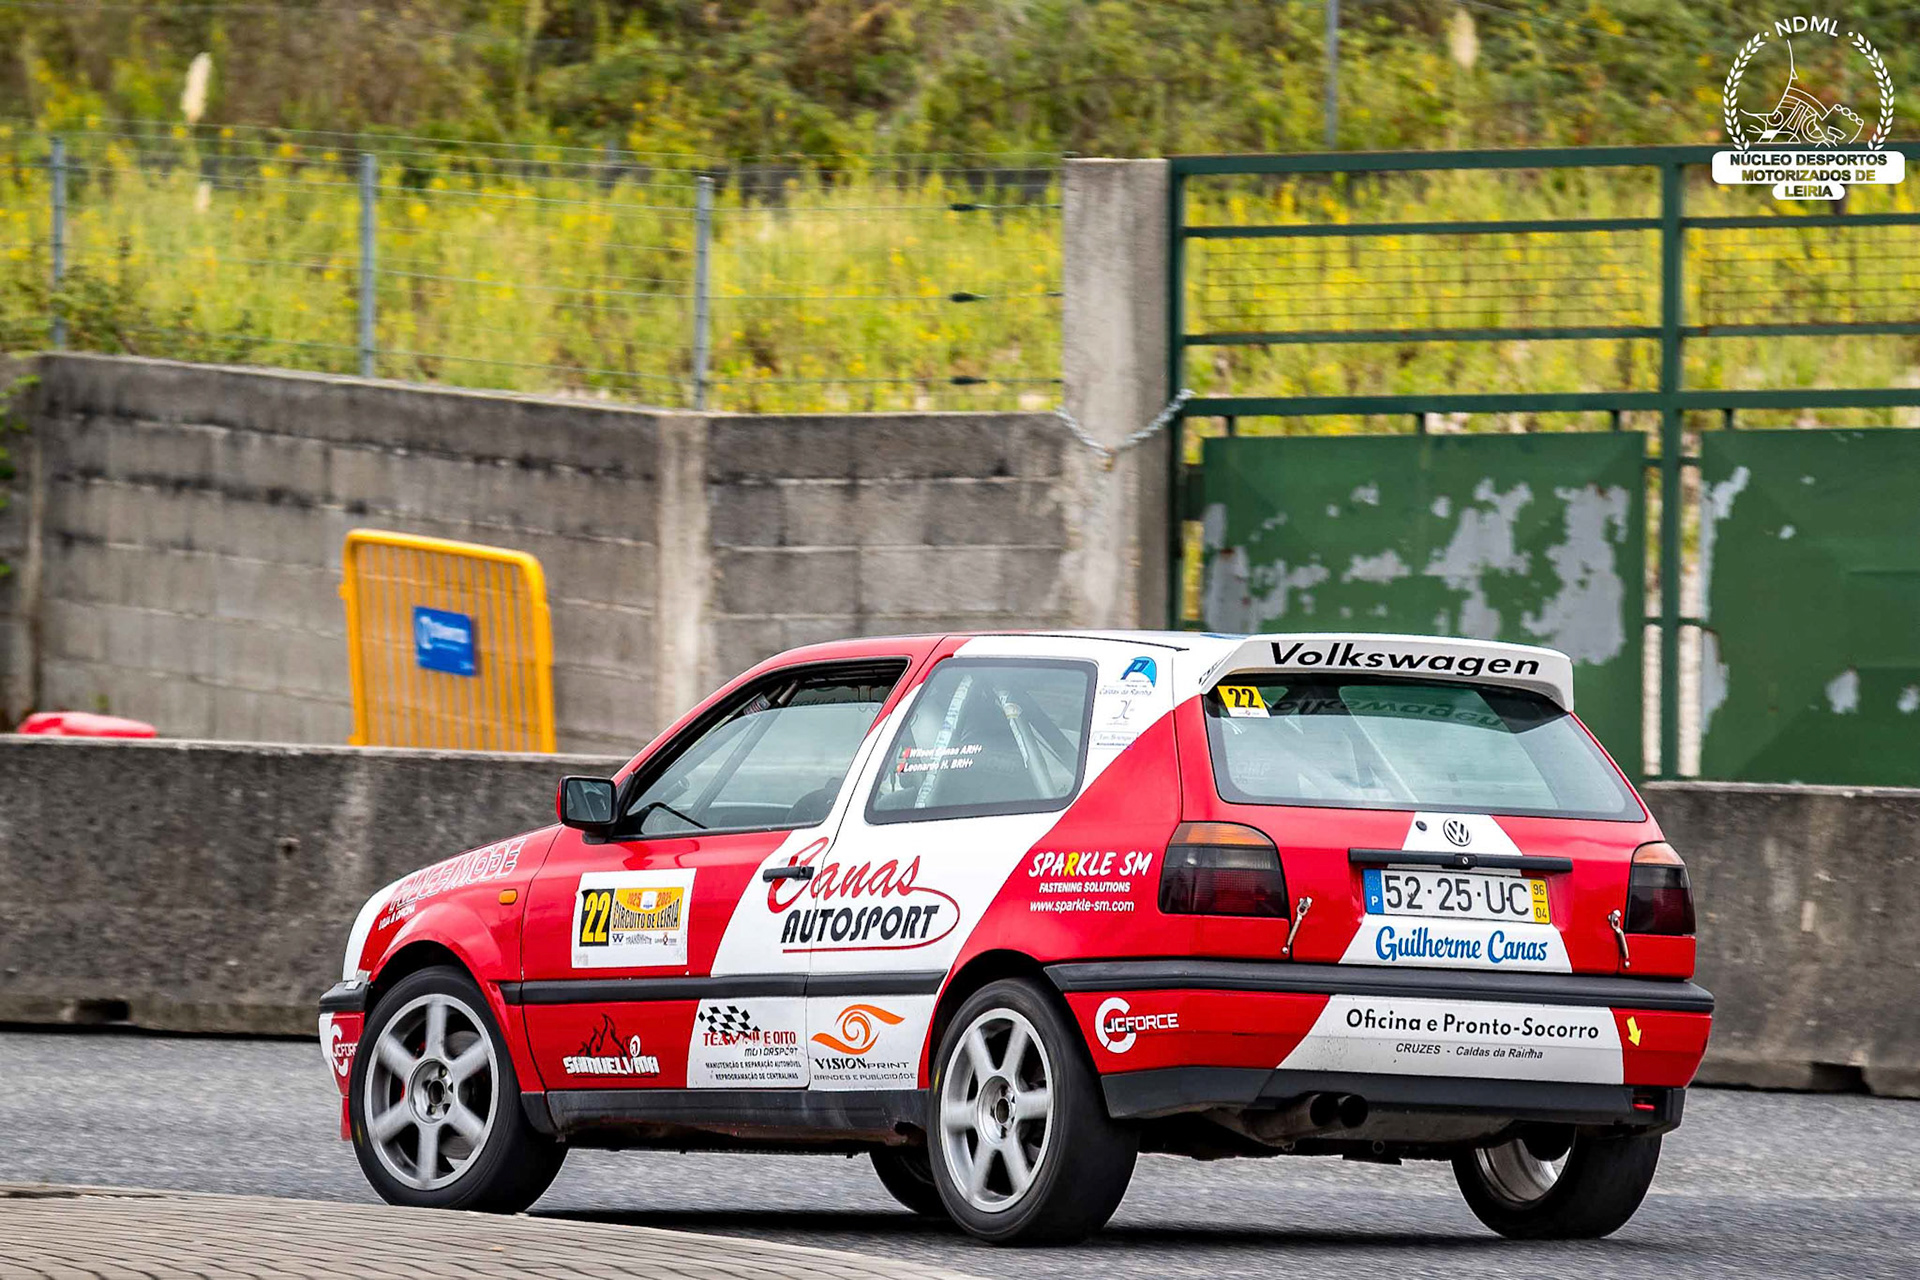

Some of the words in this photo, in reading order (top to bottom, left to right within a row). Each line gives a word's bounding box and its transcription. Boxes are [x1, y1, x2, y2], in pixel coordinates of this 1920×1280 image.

[1270, 642, 1540, 676] Volkswagen
[1228, 688, 1260, 708] 22
[1028, 851, 1117, 877] SPARKLE
[1119, 851, 1153, 876] SM
[1038, 882, 1083, 893] FASTENING
[1083, 881, 1131, 893] SOLUTIONS
[1533, 884, 1545, 896] 96
[1030, 898, 1135, 914] www.sparkle-sm.com
[1371, 895, 1379, 906] P
[581, 892, 611, 943] 22
[1536, 907, 1548, 919] 04
[781, 905, 940, 943] AUTOSPORT
[1375, 925, 1482, 962] Guilherme
[1488, 930, 1549, 963] Canas
[1346, 1008, 1421, 1031] Oficina
[1427, 1019, 1438, 1031] e
[1443, 1013, 1599, 1039] Pronto-Socorro
[773, 1031, 796, 1045] OITO
[1396, 1042, 1441, 1055] CRUZES
[1456, 1046, 1490, 1057] Caldas
[1493, 1047, 1505, 1058] da
